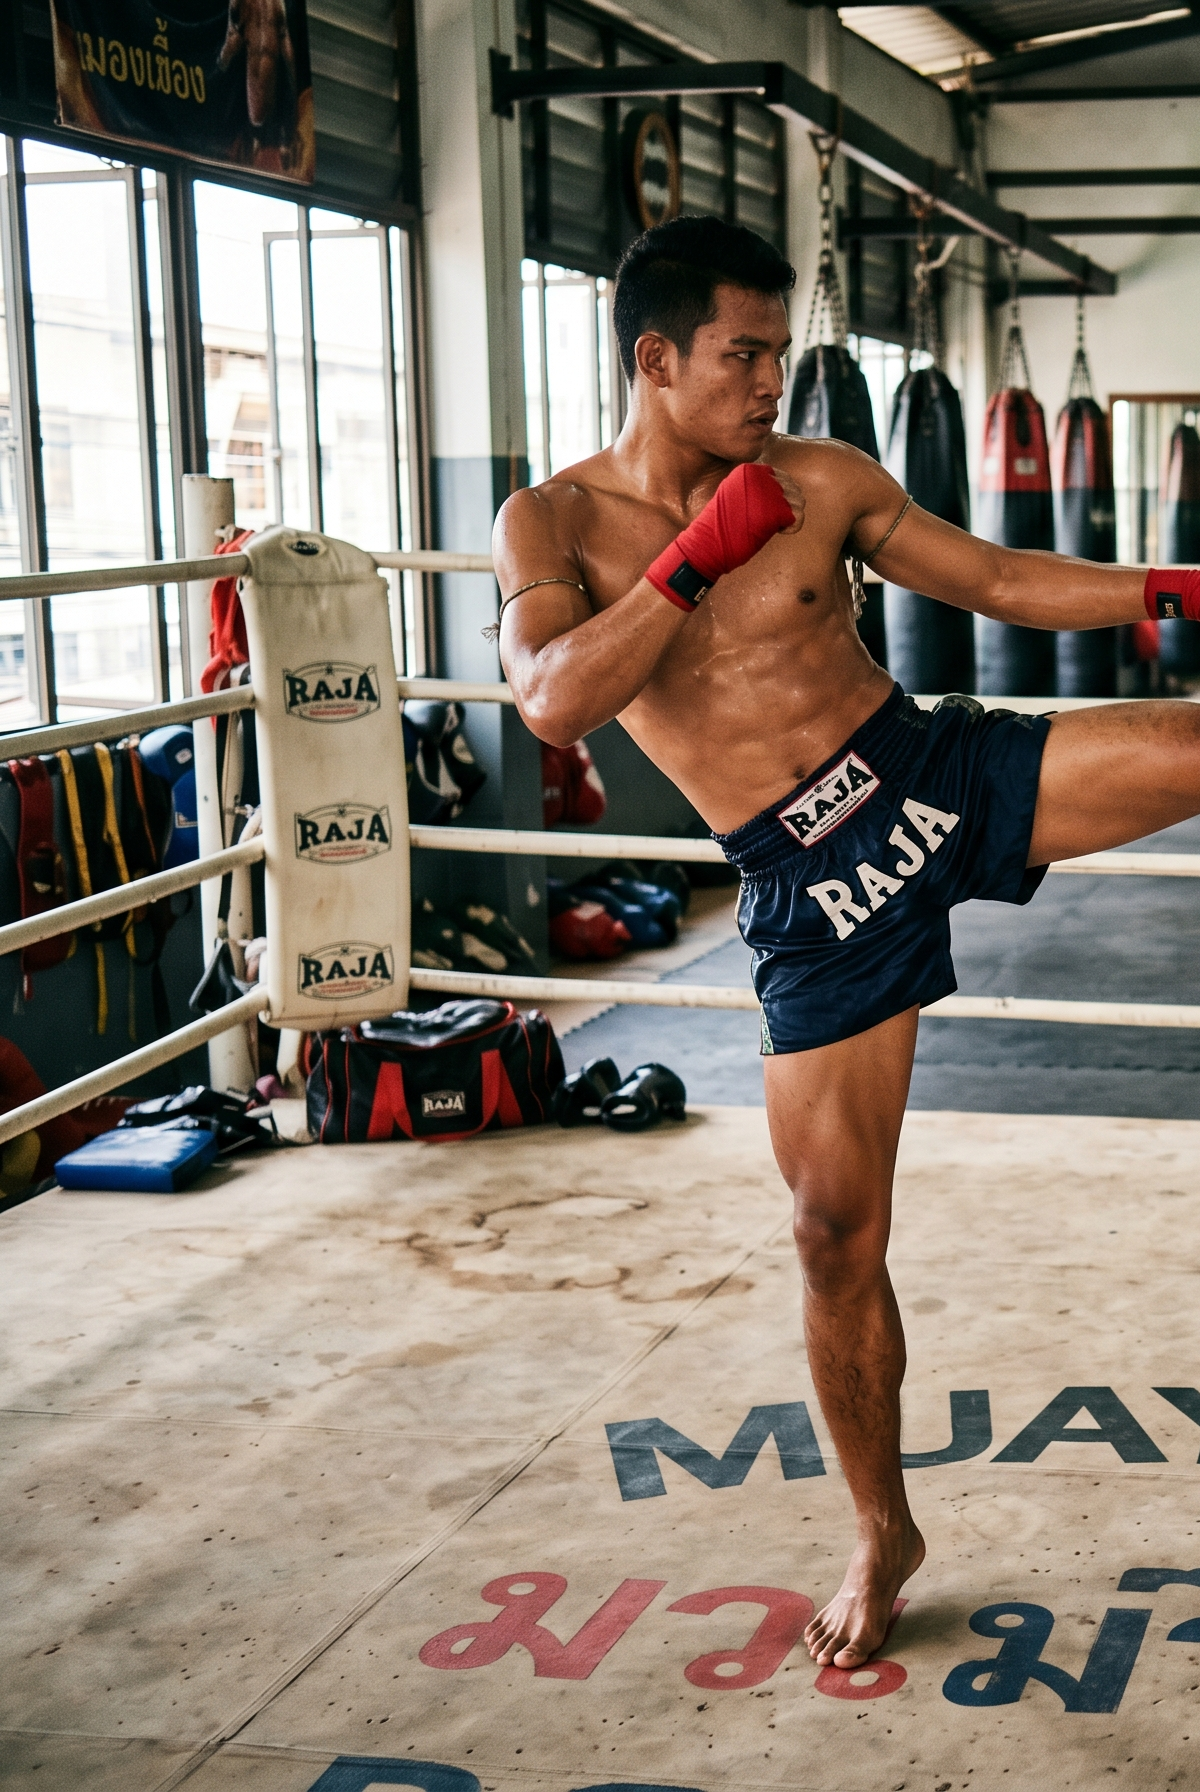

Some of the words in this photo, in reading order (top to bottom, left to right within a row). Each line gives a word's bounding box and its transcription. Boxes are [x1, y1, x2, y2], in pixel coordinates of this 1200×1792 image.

[286, 672, 377, 708] RAJA
[782, 761, 874, 840] RAJA
[298, 813, 388, 851] RAJA
[806, 797, 960, 941] RAJA
[301, 951, 391, 990] RAJA
[424, 1095, 463, 1113] RAJA
